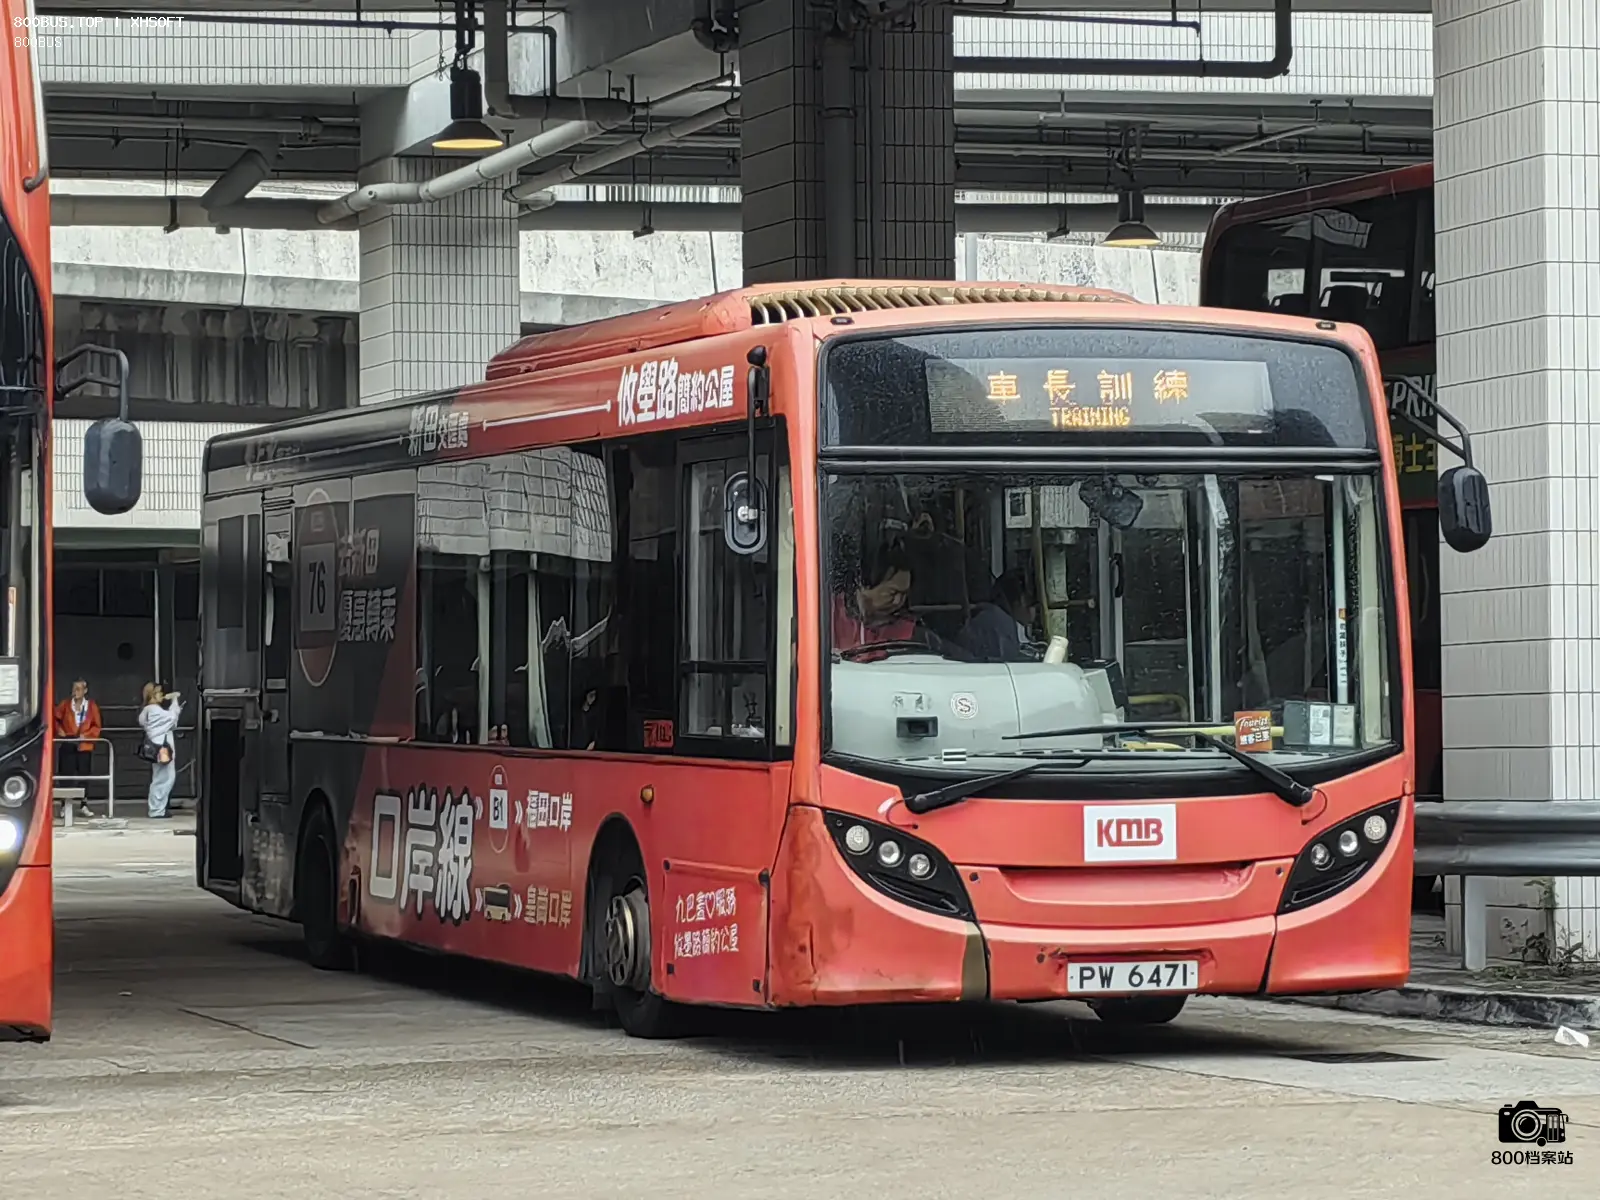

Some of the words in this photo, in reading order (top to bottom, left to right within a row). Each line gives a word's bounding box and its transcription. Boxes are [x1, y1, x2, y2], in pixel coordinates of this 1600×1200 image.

[986, 369, 1189, 405] 車長訓練
[1050, 405, 1132, 428] TRAINING
[309, 560, 326, 614] 76
[1096, 818, 1164, 848] KMB
[369, 783, 475, 924] 口岸線
[1078, 965, 1115, 989] PW
[1128, 963, 1188, 987] 6471
